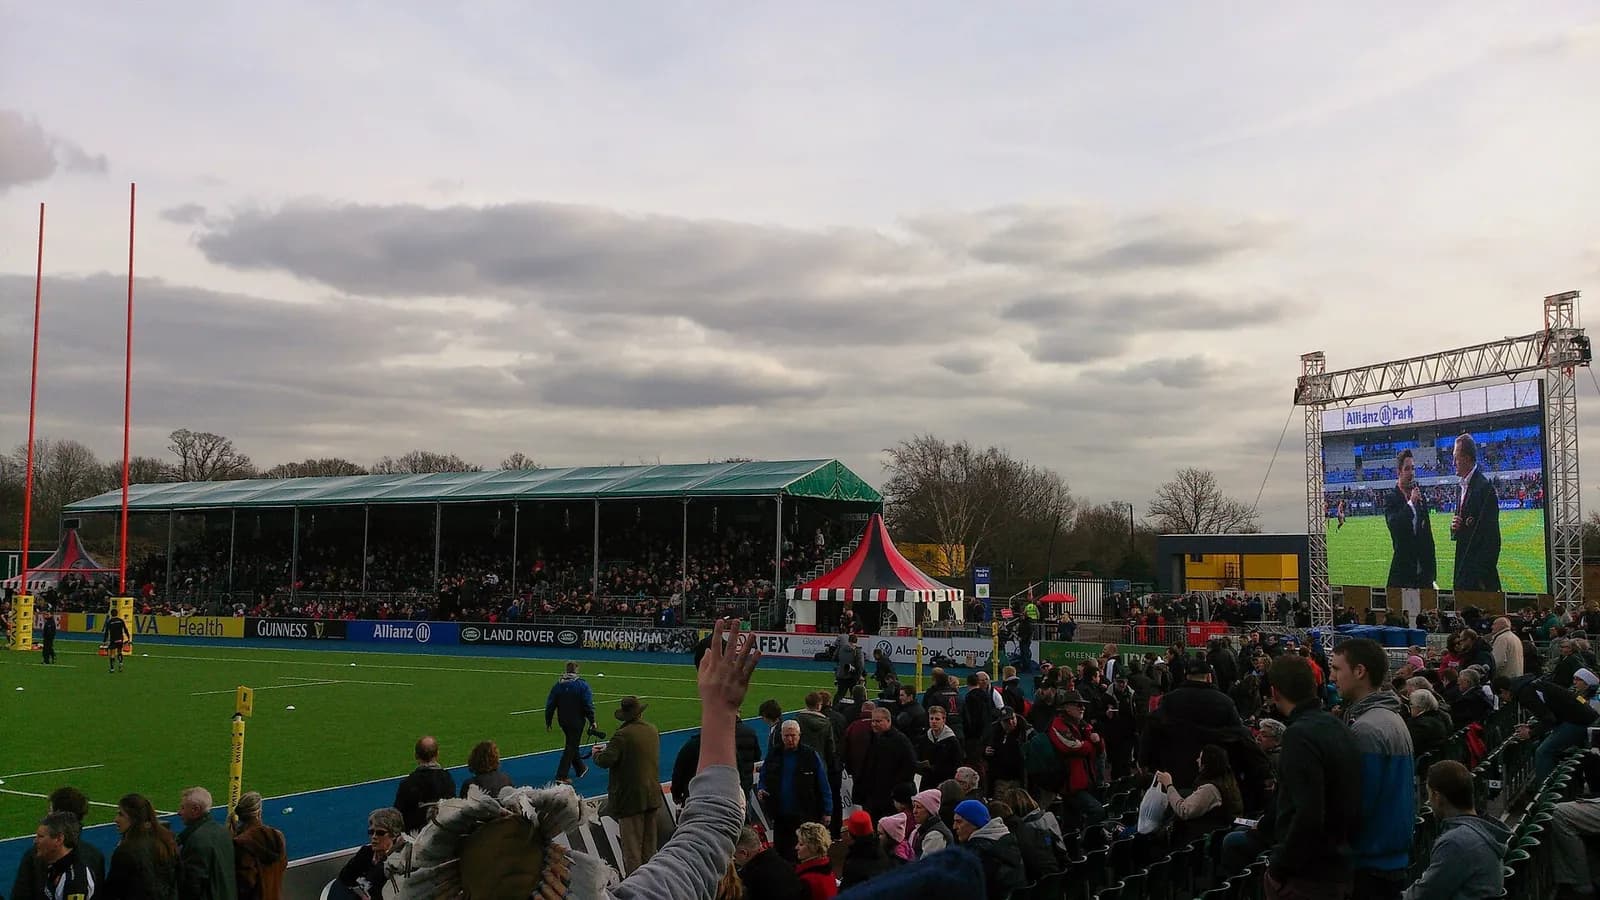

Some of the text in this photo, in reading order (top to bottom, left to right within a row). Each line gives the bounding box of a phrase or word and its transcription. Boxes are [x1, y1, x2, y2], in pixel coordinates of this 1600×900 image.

[1346, 406, 1414, 426] Allianz Park
[178, 616, 224, 636] Health
[257, 619, 308, 638] GUINNESS
[373, 623, 414, 639] Allianz
[483, 629, 514, 642] LAND
[516, 630, 554, 643] ROVER
[583, 629, 662, 644] TWICKENHAM
[601, 641, 617, 649] MAY
